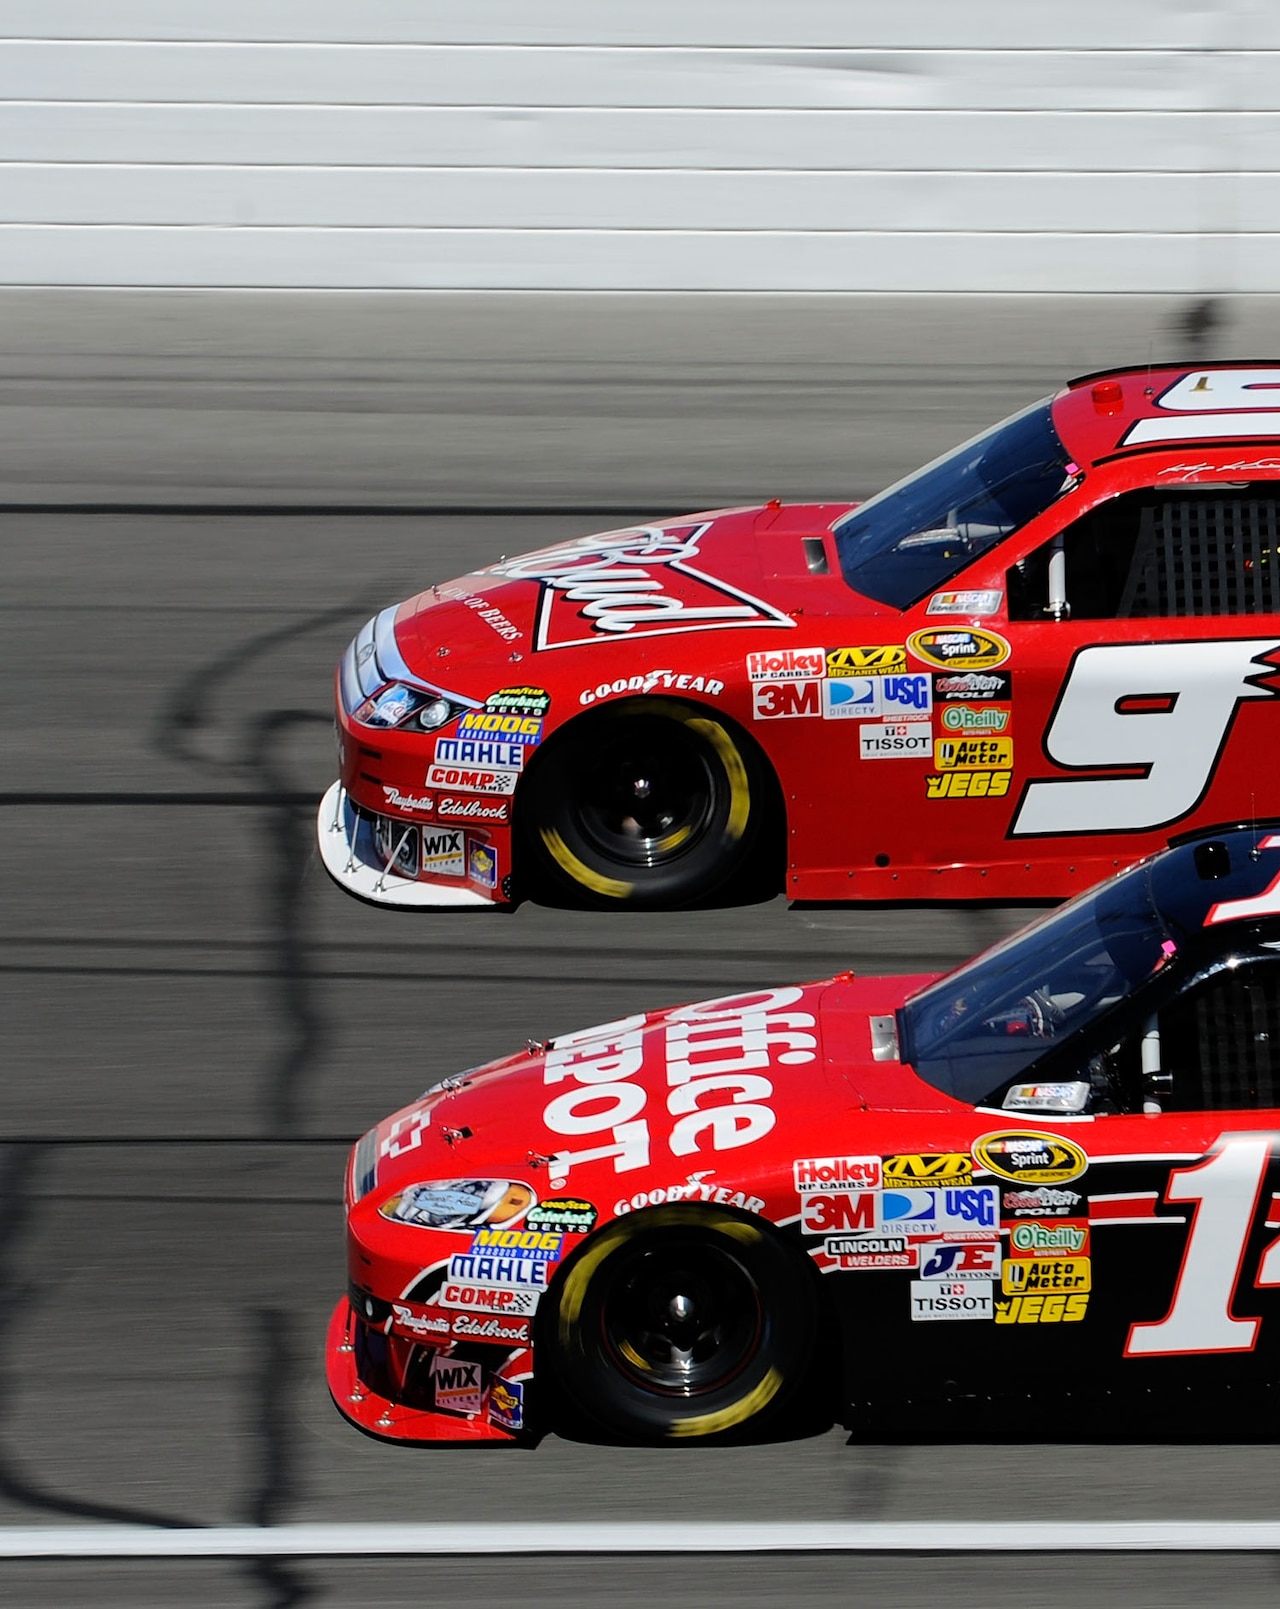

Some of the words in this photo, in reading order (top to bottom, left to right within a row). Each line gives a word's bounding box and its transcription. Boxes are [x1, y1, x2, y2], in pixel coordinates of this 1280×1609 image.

[941, 643, 977, 657] Sprint
[750, 652, 824, 676] Holley
[827, 666, 878, 678] MECHANIX
[878, 664, 908, 675] WEAR
[770, 671, 811, 679] CARBS
[579, 669, 725, 706] GOODYEAR
[884, 676, 928, 709] USG
[945, 691, 996, 699] POLE
[485, 694, 550, 709] Gatorback
[757, 682, 820, 717] 3M
[486, 706, 543, 716] BELTS
[829, 706, 874, 716] DIRECTV
[945, 707, 1008, 729] O'Reilly
[458, 713, 542, 735] MOOG
[862, 737, 930, 751] TISSOT
[958, 741, 998, 753] Auto
[436, 740, 522, 767] MAHLE
[955, 753, 1007, 767] Meter
[431, 768, 495, 786] COMP
[926, 771, 1012, 798] JEGS
[473, 784, 505, 792] CAMS
[437, 797, 508, 821] Edelbrock
[423, 832, 462, 856] WIX
[664, 986, 818, 1158] Office
[1010, 1152, 1049, 1168] Sprint
[797, 1159, 879, 1188] Holley
[883, 1177, 940, 1189] MECHANIX
[940, 1175, 973, 1187] WEAR
[612, 1169, 766, 1217] GOODYEAR
[819, 1181, 866, 1190] CARBS
[804, 1193, 875, 1232] 3M
[945, 1188, 995, 1226] USG
[1014, 1207, 1071, 1216] POLE
[526, 1207, 597, 1225] Gatorback
[527, 1223, 589, 1233] BELTS
[881, 1223, 937, 1234] DIRECTV
[1015, 1224, 1083, 1249] O'Reilly
[471, 1229, 563, 1251] MOOG
[830, 1239, 903, 1255] LINCOLN
[471, 1246, 518, 1258] CHASSIS
[522, 1249, 558, 1262] PARTS
[847, 1254, 910, 1267] WELDERS
[922, 1244, 996, 1277] JE
[450, 1255, 547, 1285] MAHLE
[944, 1271, 1000, 1279] PISTONS
[1028, 1262, 1075, 1275] Auto
[1026, 1275, 1085, 1291] Meter
[444, 1285, 515, 1307] COMP
[914, 1297, 991, 1311] TISSOT
[490, 1304, 526, 1314] CAMS
[994, 1294, 1090, 1325] JEGS
[452, 1314, 529, 1341] Edelbrock
[435, 1364, 479, 1391] WIX
